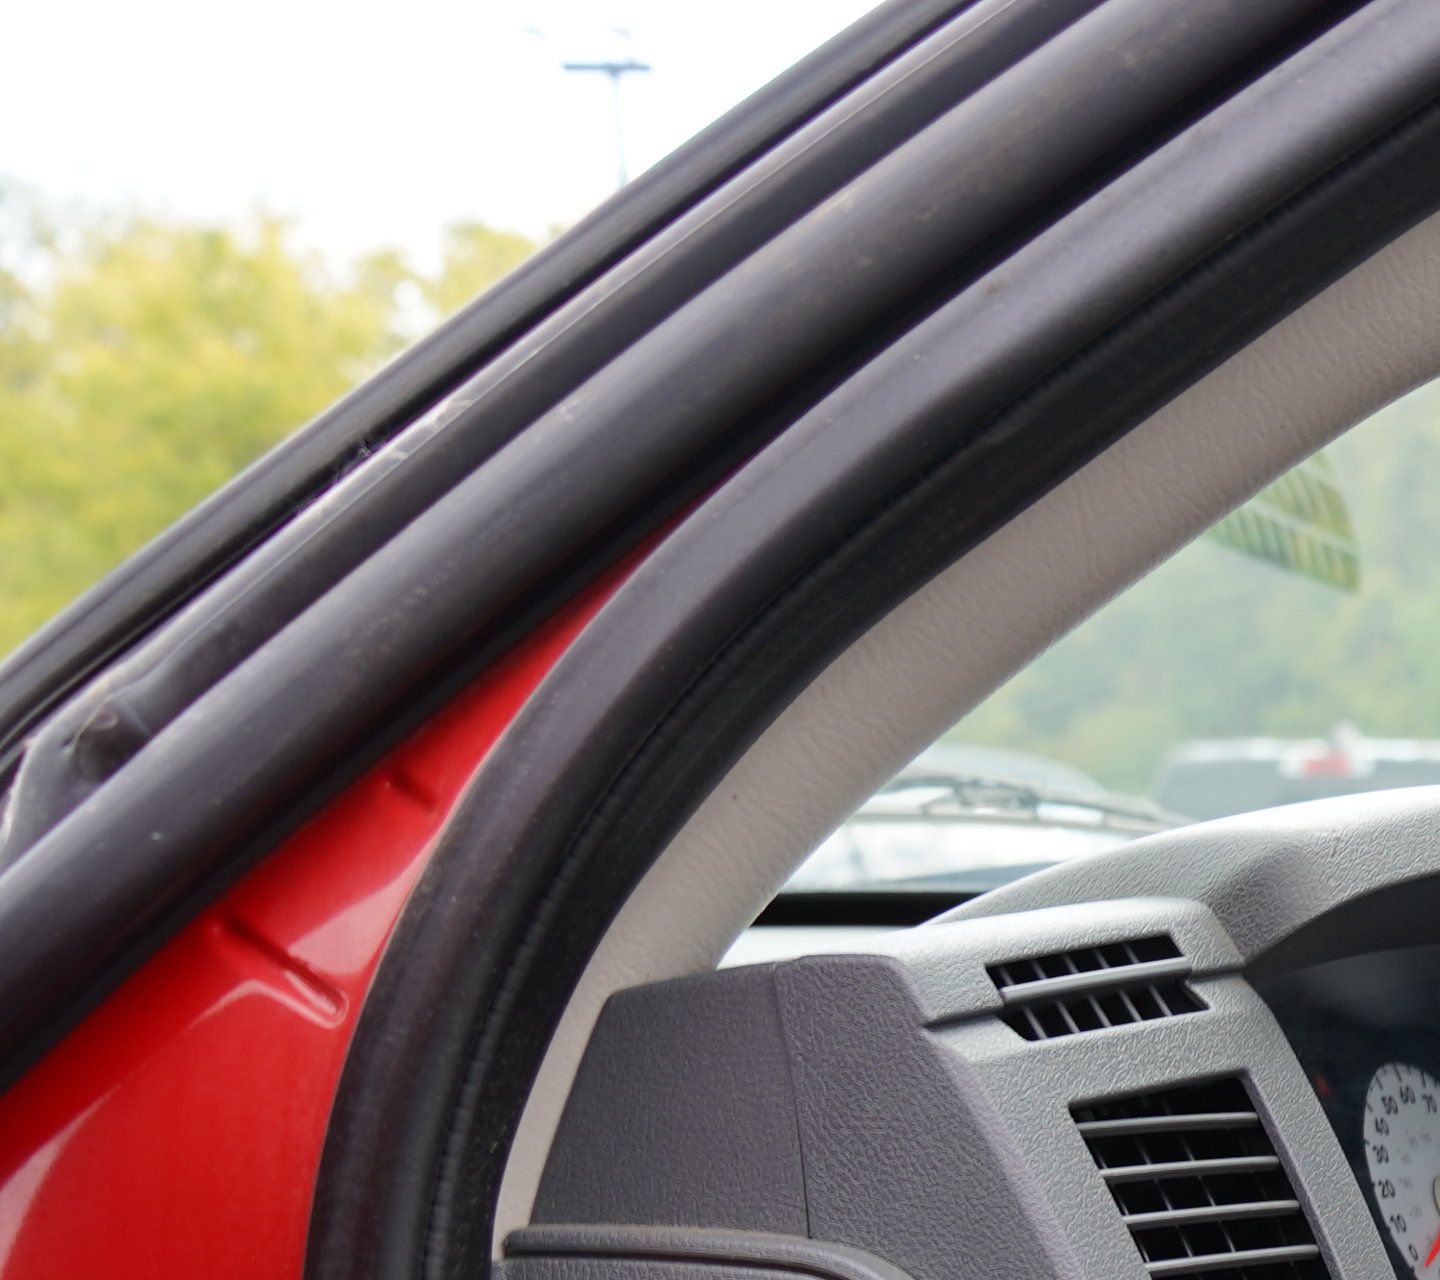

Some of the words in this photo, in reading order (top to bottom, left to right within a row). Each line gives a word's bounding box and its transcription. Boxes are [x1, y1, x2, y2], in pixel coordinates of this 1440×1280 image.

[1381, 1095, 1399, 1115] 50
[1399, 1086, 1416, 1105] 60
[1422, 1094, 1438, 1114] 70
[1374, 1118, 1390, 1136] 40
[1374, 1145, 1389, 1164] 30
[1378, 1179, 1396, 1198] 20
[1390, 1214, 1408, 1233] 10
[1408, 1244, 1419, 1262] 0
